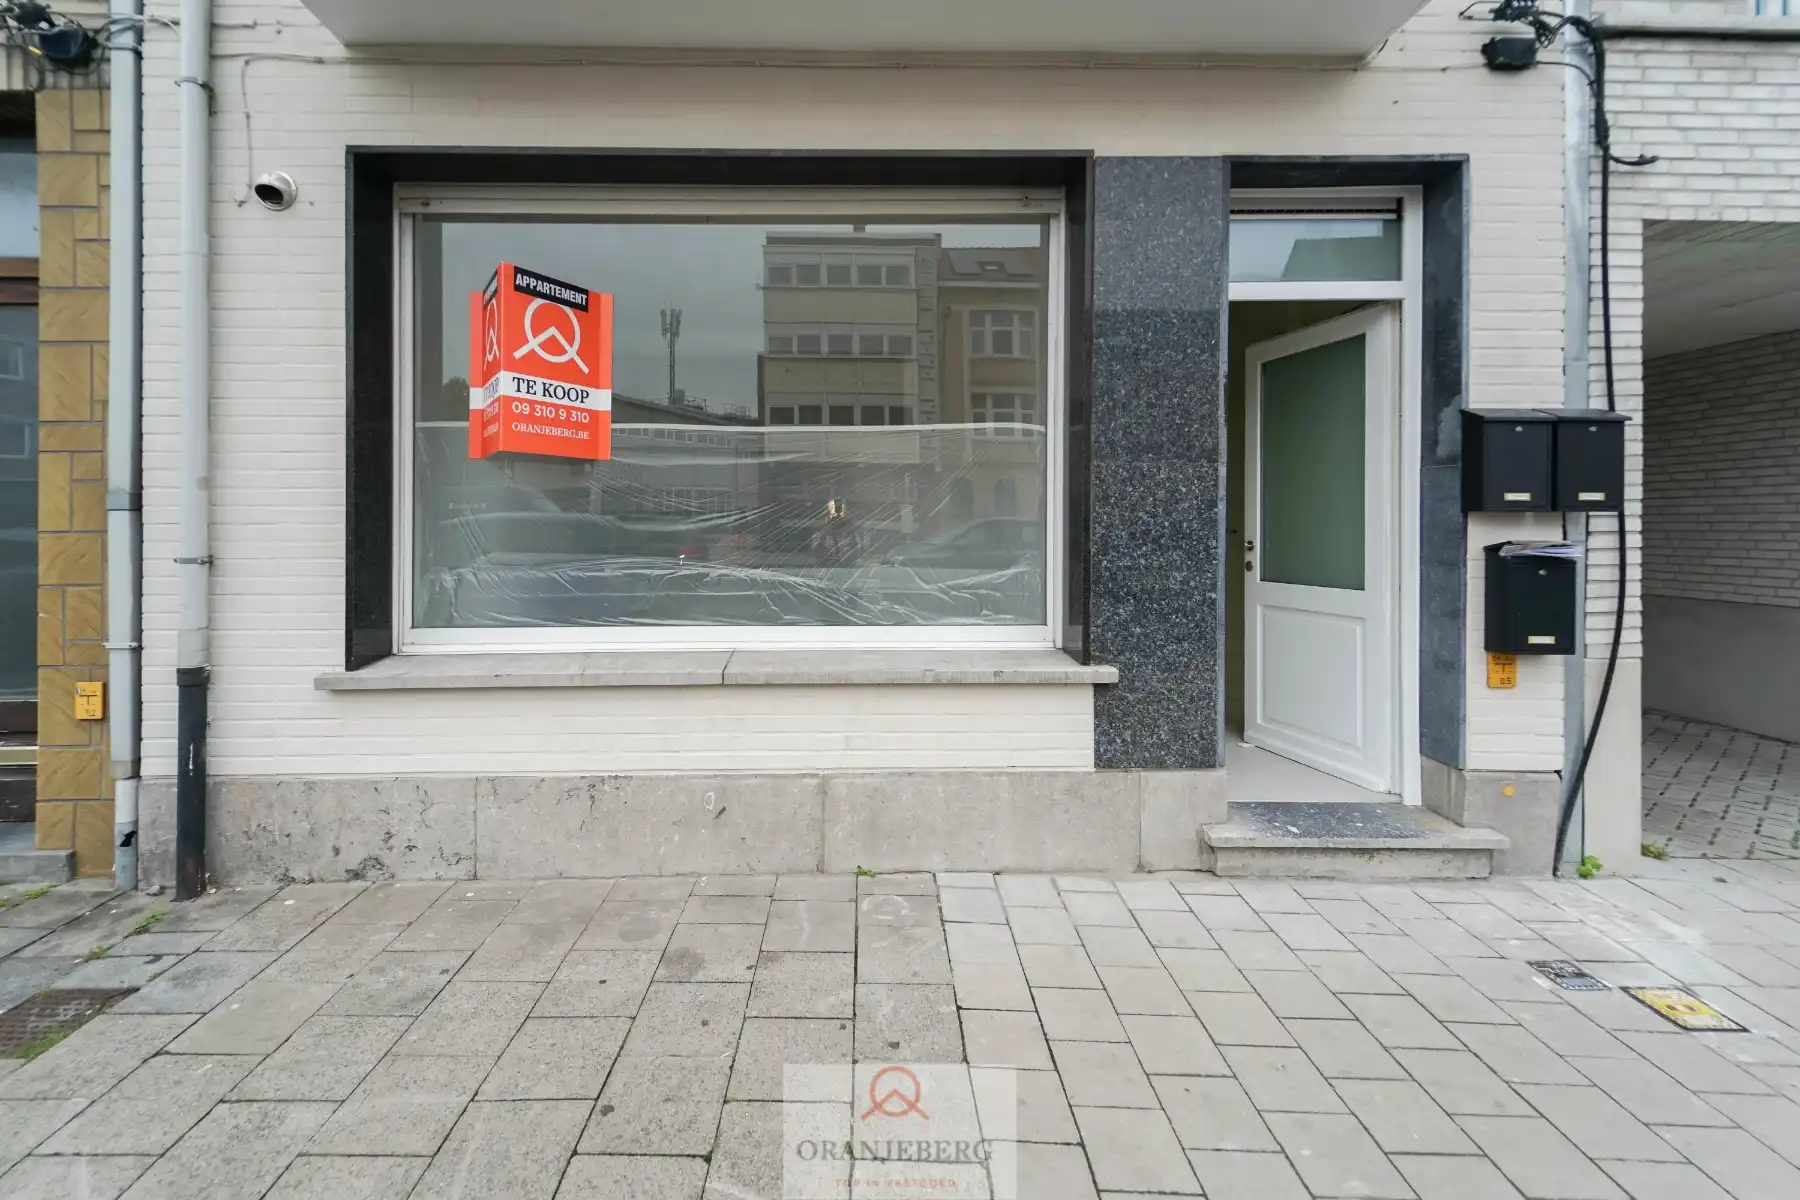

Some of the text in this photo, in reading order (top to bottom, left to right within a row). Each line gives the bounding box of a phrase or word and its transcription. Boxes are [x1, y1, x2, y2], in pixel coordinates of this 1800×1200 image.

[515, 273, 588, 306] APPARTEMENT
[512, 376, 537, 396] TE
[541, 381, 590, 404] KOOP
[512, 401, 530, 415] 09
[534, 404, 555, 418] 310
[559, 408, 566, 420] 9
[570, 410, 590, 423] 310
[512, 421, 590, 440] ORANJEBERG.BE
